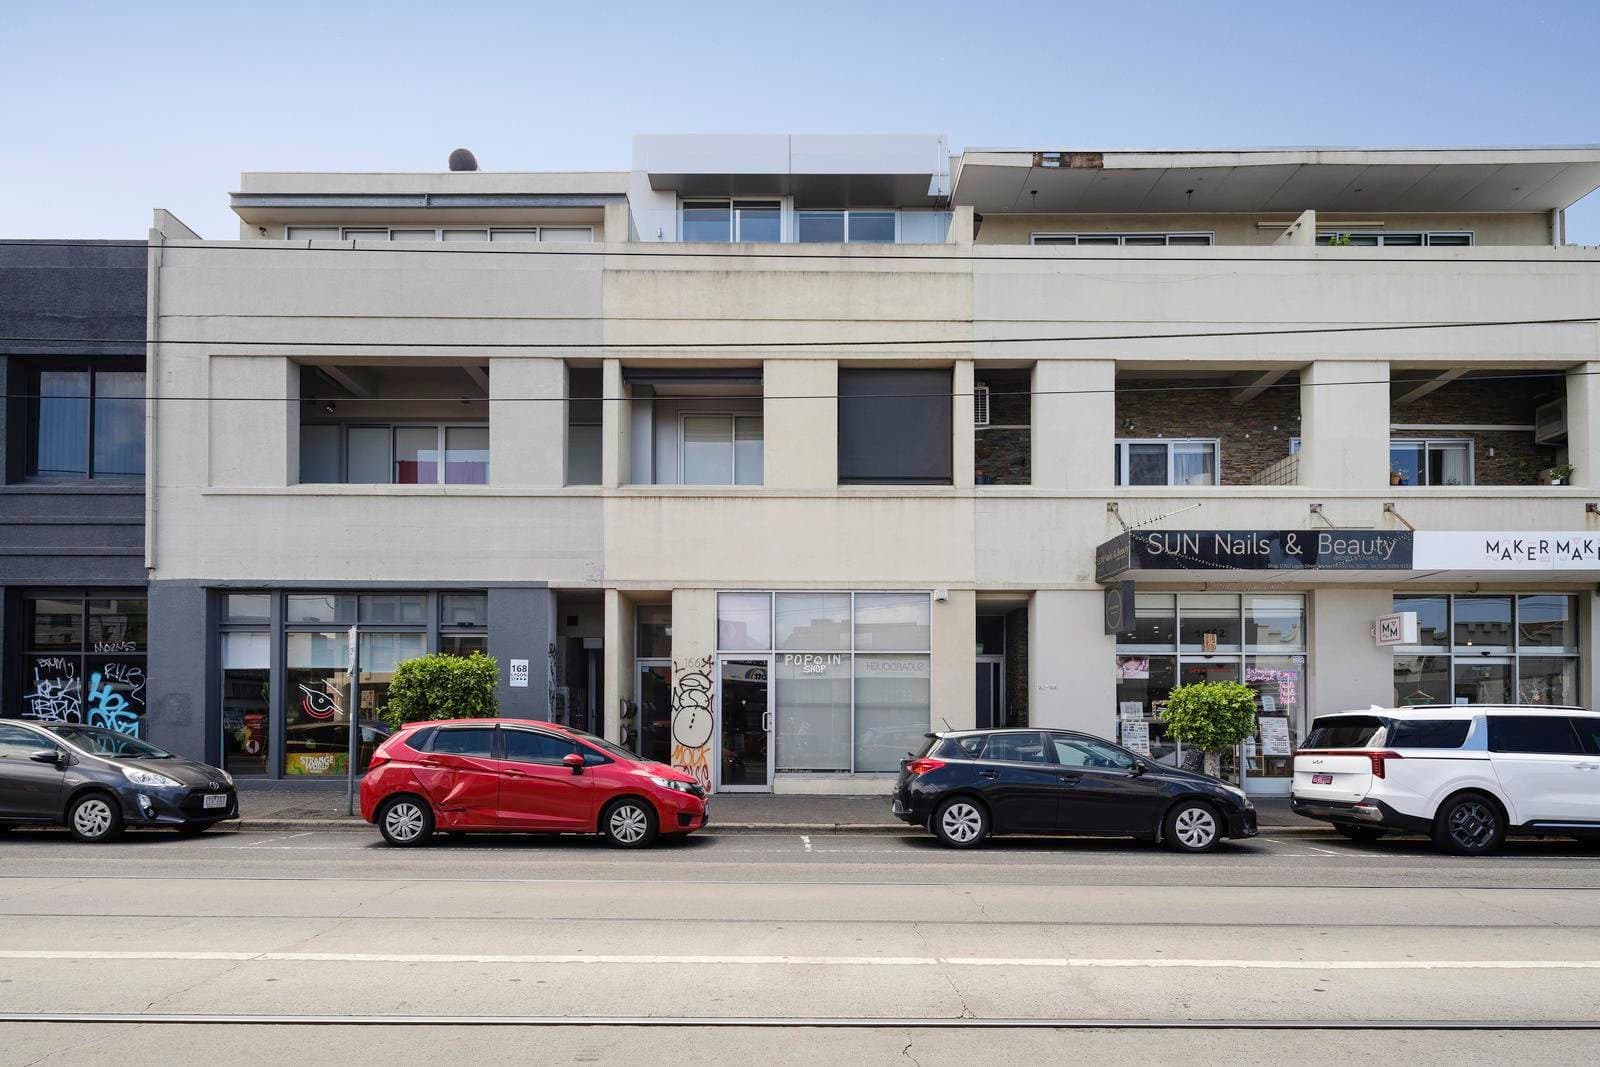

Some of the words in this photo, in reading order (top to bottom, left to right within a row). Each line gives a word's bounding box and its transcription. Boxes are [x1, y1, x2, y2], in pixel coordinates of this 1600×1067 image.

[1147, 533, 1199, 555] SUN
[1215, 532, 1270, 555] Nails
[1285, 533, 1303, 555] &
[1318, 533, 1397, 560] Beauty
[1486, 540, 1549, 561] MAKER
[1556, 540, 1600, 561] MAK
[511, 664, 528, 673] 168
[803, 664, 826, 673] SHOP
[300, 755, 334, 765] STRANGE
[305, 762, 330, 770] WORLD
